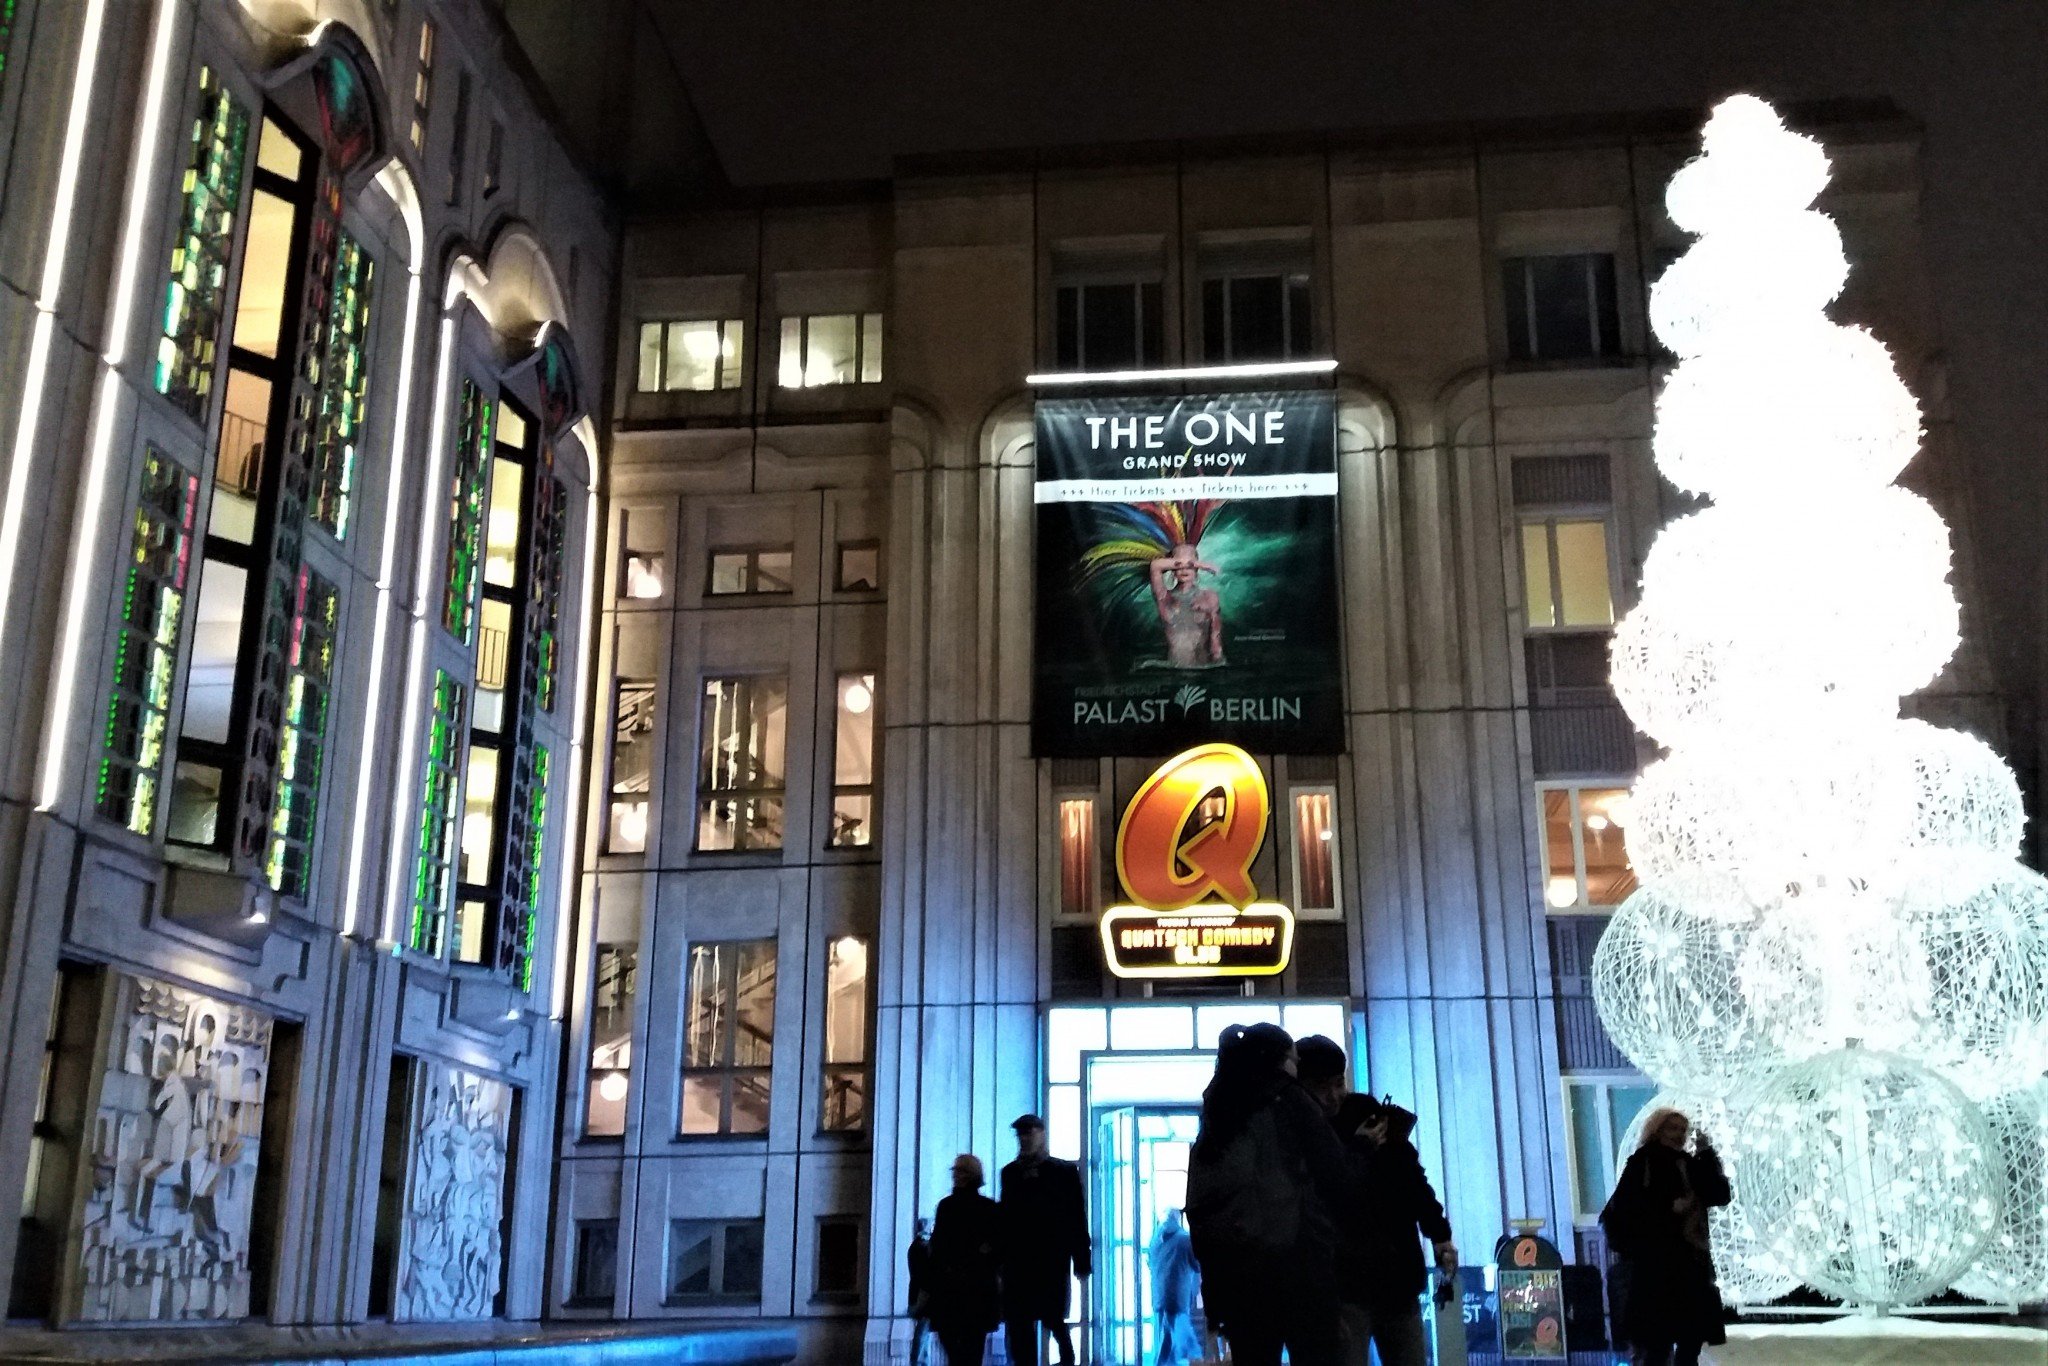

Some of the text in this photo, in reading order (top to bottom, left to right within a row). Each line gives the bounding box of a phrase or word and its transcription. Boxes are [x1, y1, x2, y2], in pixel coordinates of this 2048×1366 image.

[1085, 411, 1285, 449] THE ONE
[1123, 453, 1247, 470] GRAND SHOW
[1124, 485, 1165, 496] Tickets
[1202, 482, 1244, 494] Tickets
[1074, 697, 1301, 724] PALAST BERLIN
[1121, 926, 1275, 949] QUATSCH COMEDY
